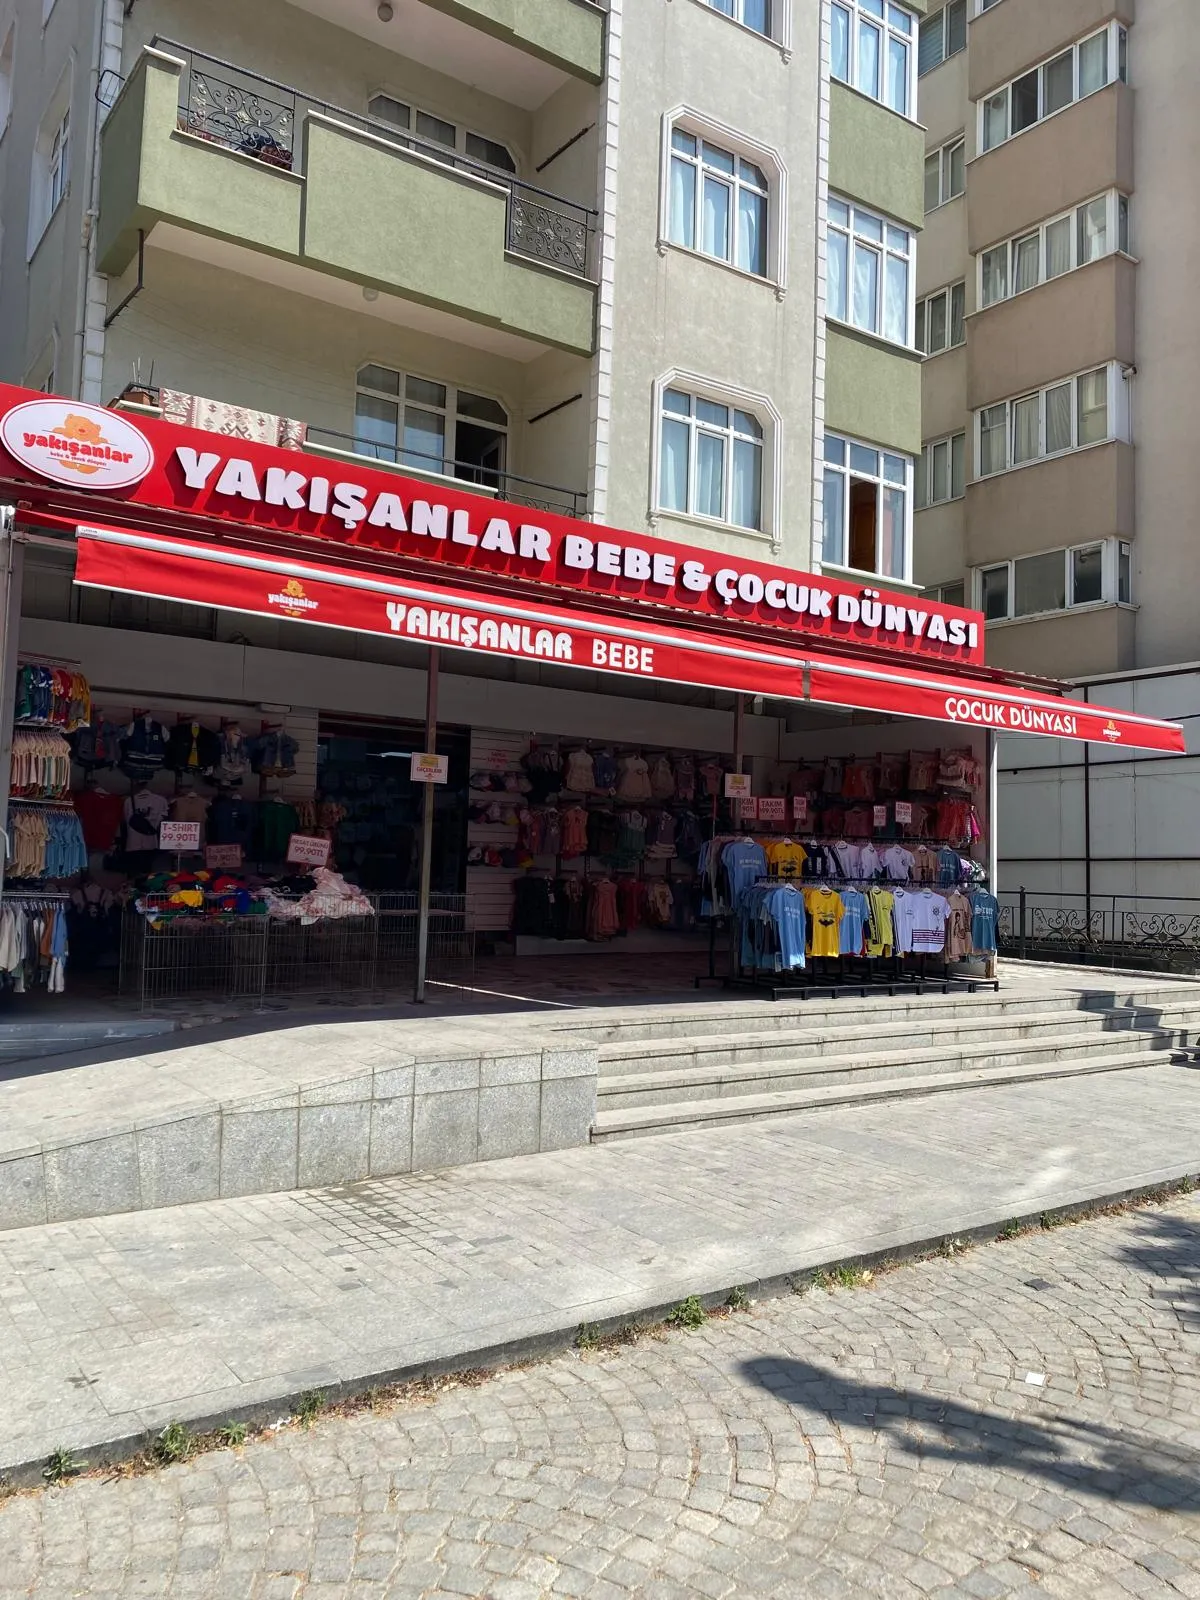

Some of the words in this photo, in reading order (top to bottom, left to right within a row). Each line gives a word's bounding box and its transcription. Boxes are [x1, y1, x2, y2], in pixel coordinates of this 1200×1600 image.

[23, 432, 133, 464] yakışanlar
[176, 446, 552, 562] YAKIŞANLAR
[564, 534, 676, 586] BEBE
[682, 560, 712, 592] &
[715, 568, 832, 618] ÇOCUK
[838, 588, 978, 648] DÜNYASI
[268, 593, 319, 609] yakışanlar
[386, 601, 573, 661] YAKIŞANLAR
[592, 638, 655, 673] BEBE
[945, 697, 1006, 721] ÇOCUK
[1010, 705, 1077, 734] DÜNYASI
[760, 800, 782, 808] TAKIM
[163, 823, 198, 832] T-SHIRT
[162, 833, 198, 842] 99.90TL
[295, 846, 324, 858] 99.90TL
